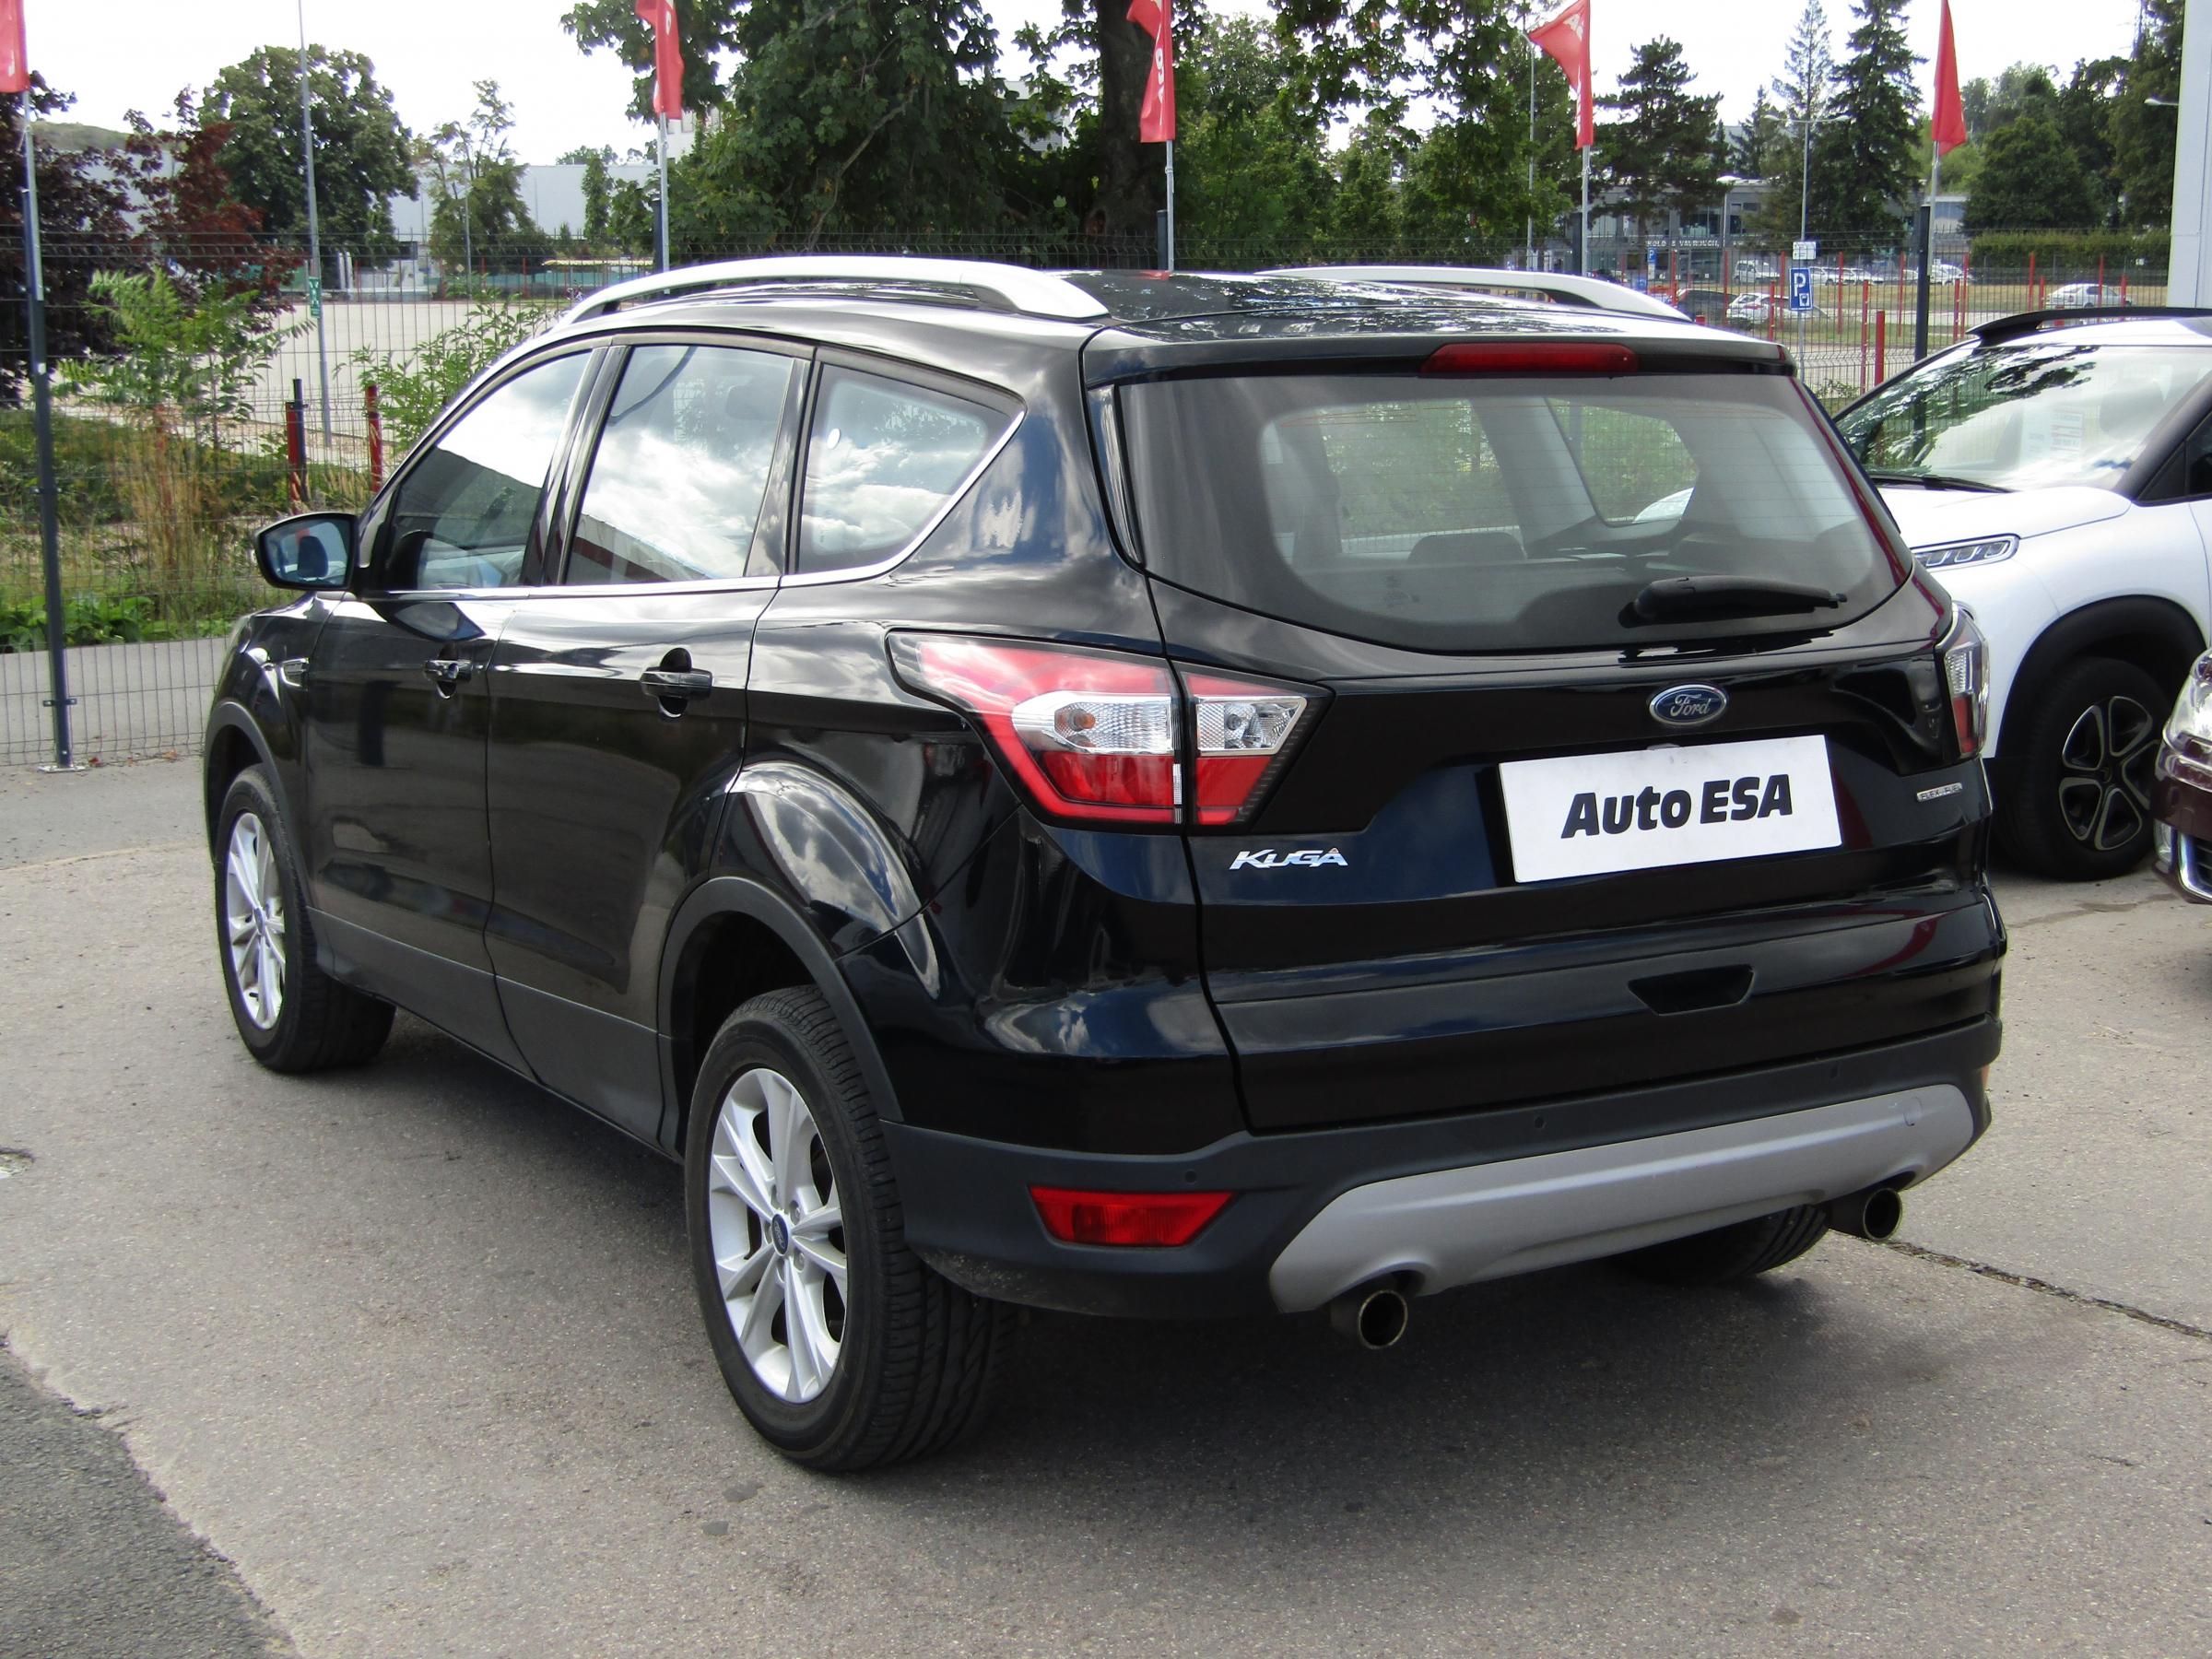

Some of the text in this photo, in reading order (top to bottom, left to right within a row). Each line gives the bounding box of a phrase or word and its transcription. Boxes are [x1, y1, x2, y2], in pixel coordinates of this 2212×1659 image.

[1794, 272, 1806, 297] P
[1670, 693, 1712, 717] Ford
[1560, 773, 1793, 839] Auto ESA
[1229, 847, 1348, 870] KUGA
